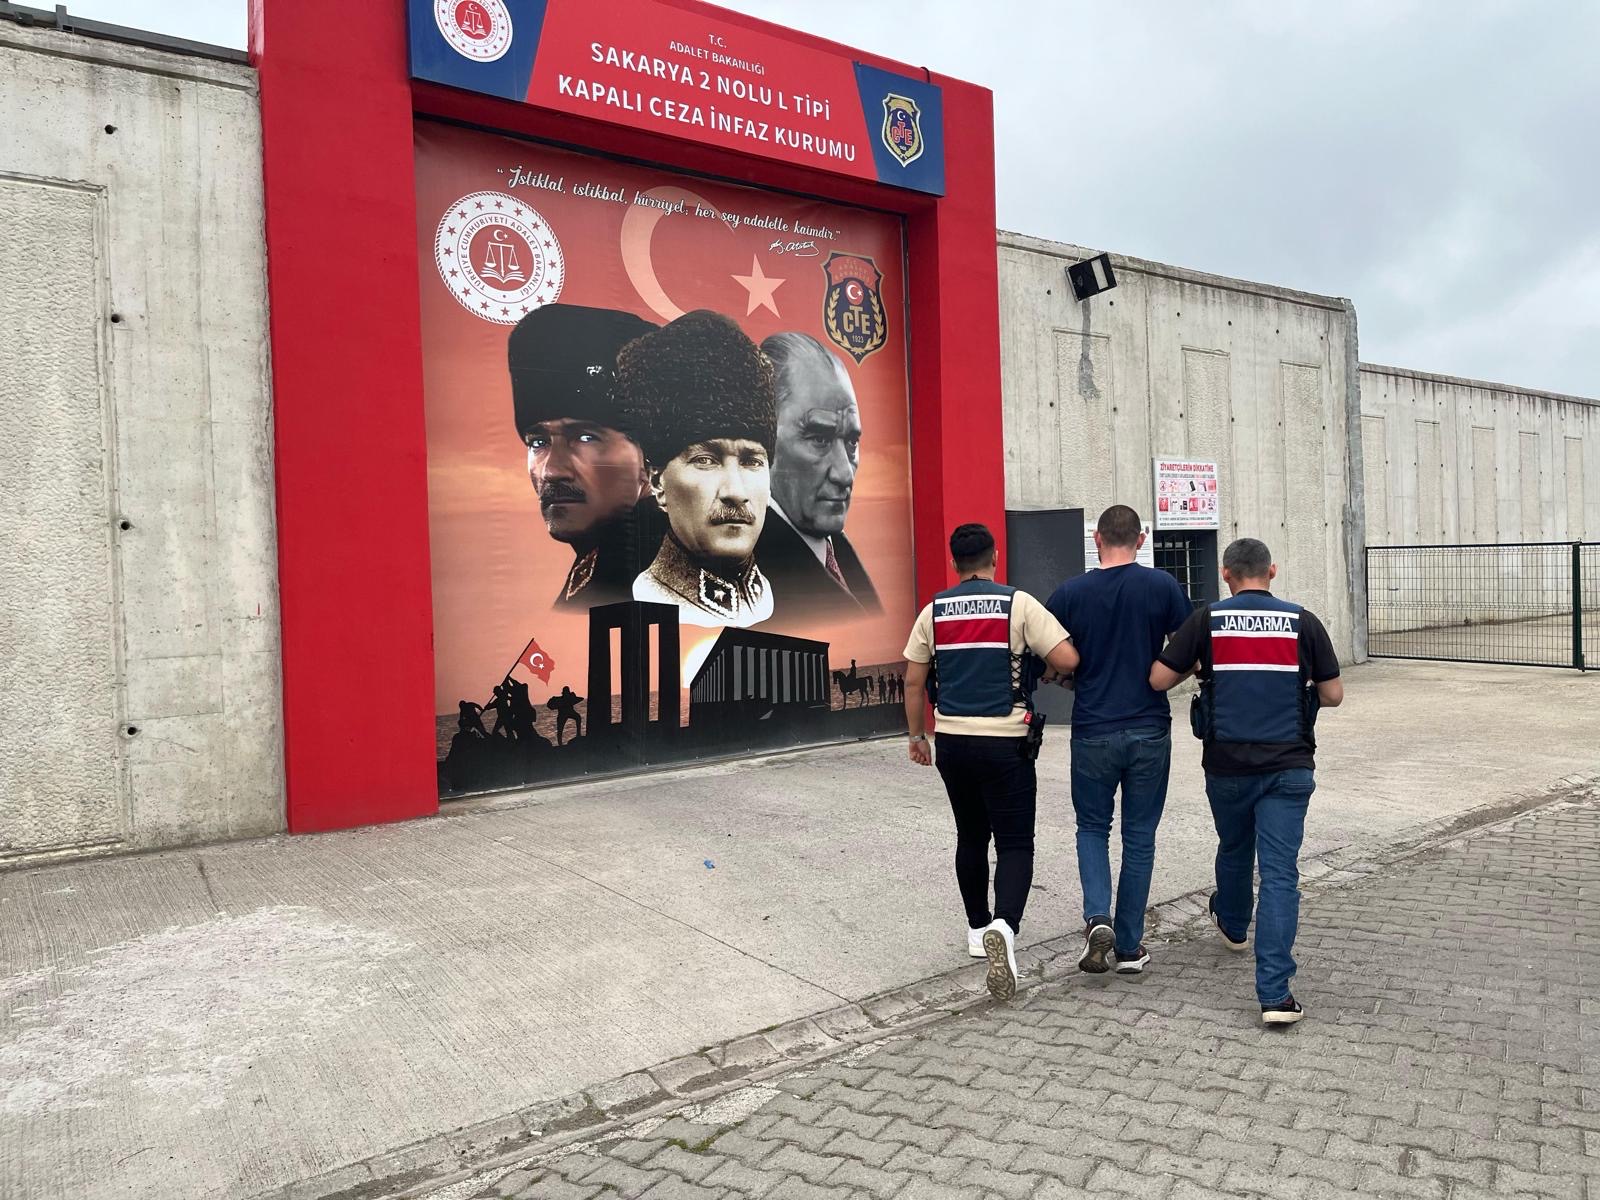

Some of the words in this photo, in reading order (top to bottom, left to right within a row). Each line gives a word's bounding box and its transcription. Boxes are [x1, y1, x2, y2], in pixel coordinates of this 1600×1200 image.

[708, 34, 727, 49] T.C.
[669, 41, 709, 60] ADALET
[712, 52, 765, 76] BAKANLIĞI
[591, 42, 694, 86] SAKARYA
[699, 71, 711, 90] 2
[717, 75, 772, 106] NOLU
[778, 91, 788, 110] L
[793, 93, 830, 121] TİPİ
[559, 74, 642, 112] KAPALI
[649, 97, 705, 126] CEZA
[710, 105, 769, 141] İNFAZ
[775, 126, 855, 162] KURUMU
[695, 202, 716, 219] her
[743, 214, 790, 232] adaletle
[510, 221, 539, 250] ADALET
[520, 253, 542, 297] BAKANLIĞI
[842, 305, 871, 335] CTE
[941, 599, 1002, 616] JANDARMA
[1220, 615, 1293, 632] JANDARMA
